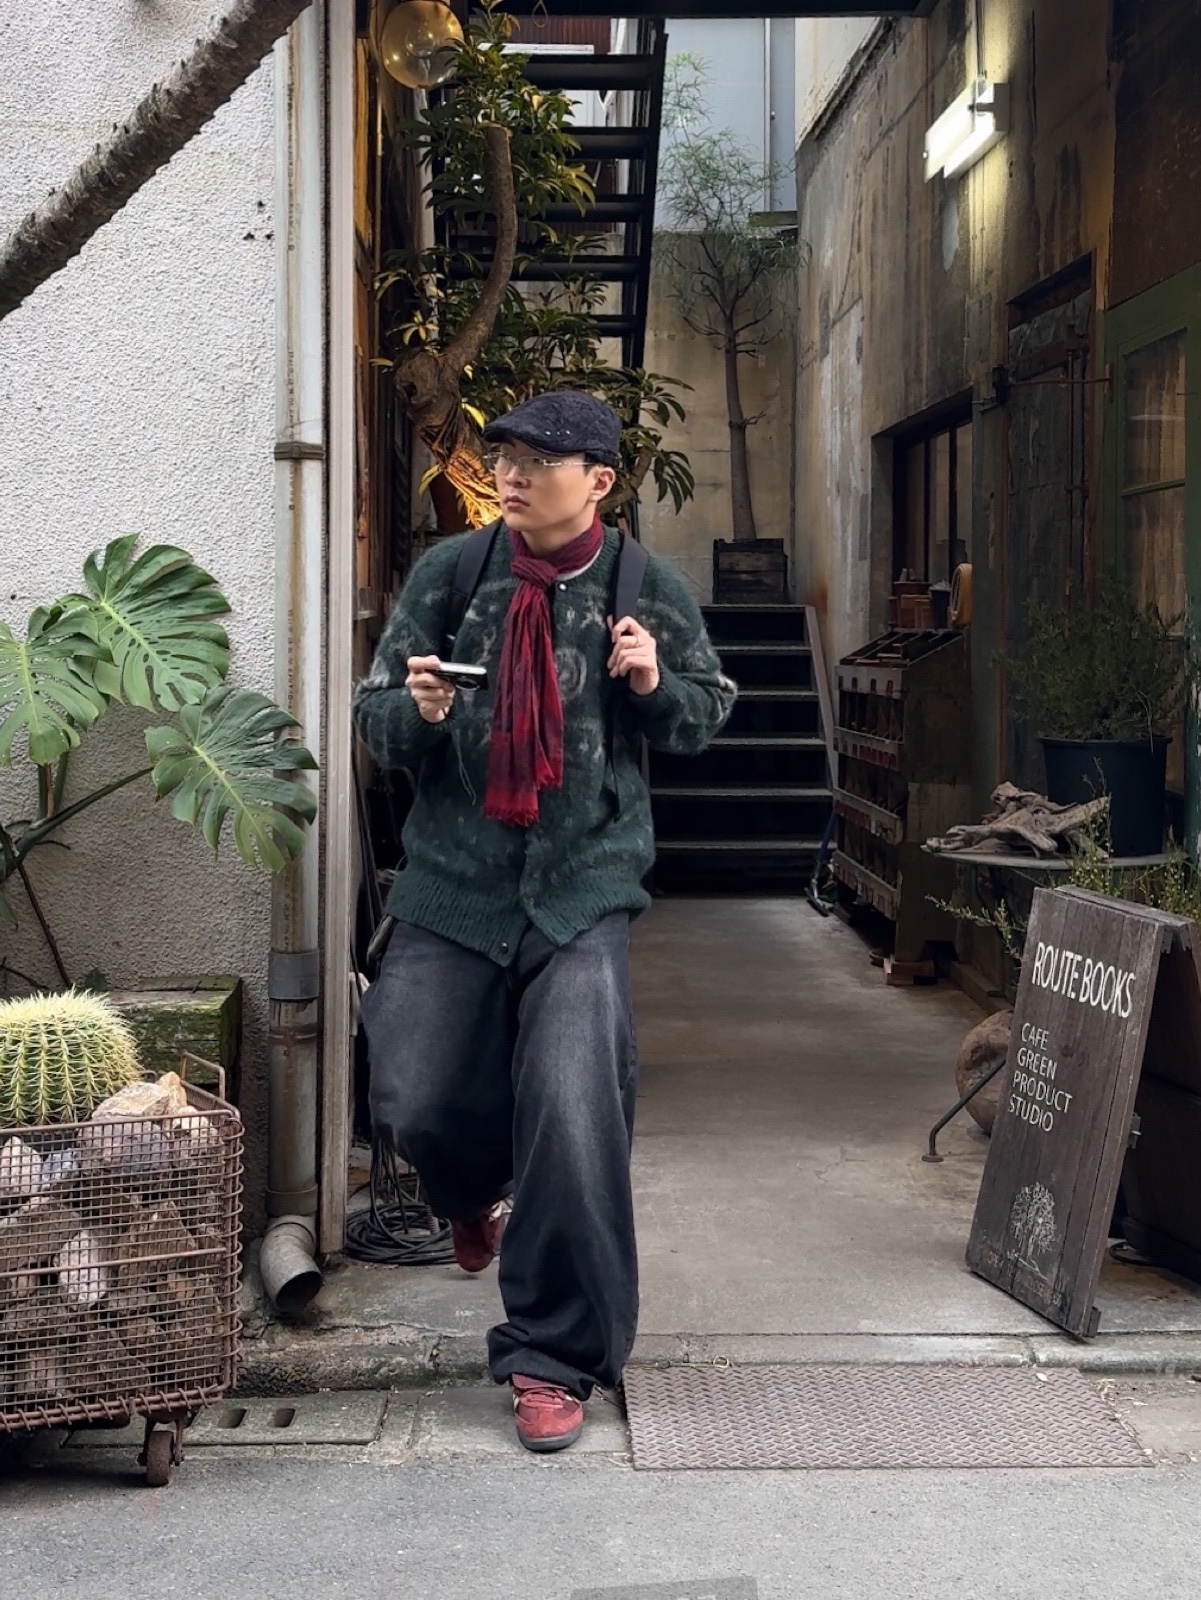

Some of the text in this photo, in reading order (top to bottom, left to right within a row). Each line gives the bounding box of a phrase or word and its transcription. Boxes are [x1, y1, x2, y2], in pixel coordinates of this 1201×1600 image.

[1032, 941, 1136, 1018] ROUTE BOOKS
[1021, 1022, 1049, 1051] CAFE
[1017, 1047, 1057, 1080] GREEN
[1013, 1070, 1073, 1113] PRODUCT
[1008, 1094, 1053, 1131] STUDIO
